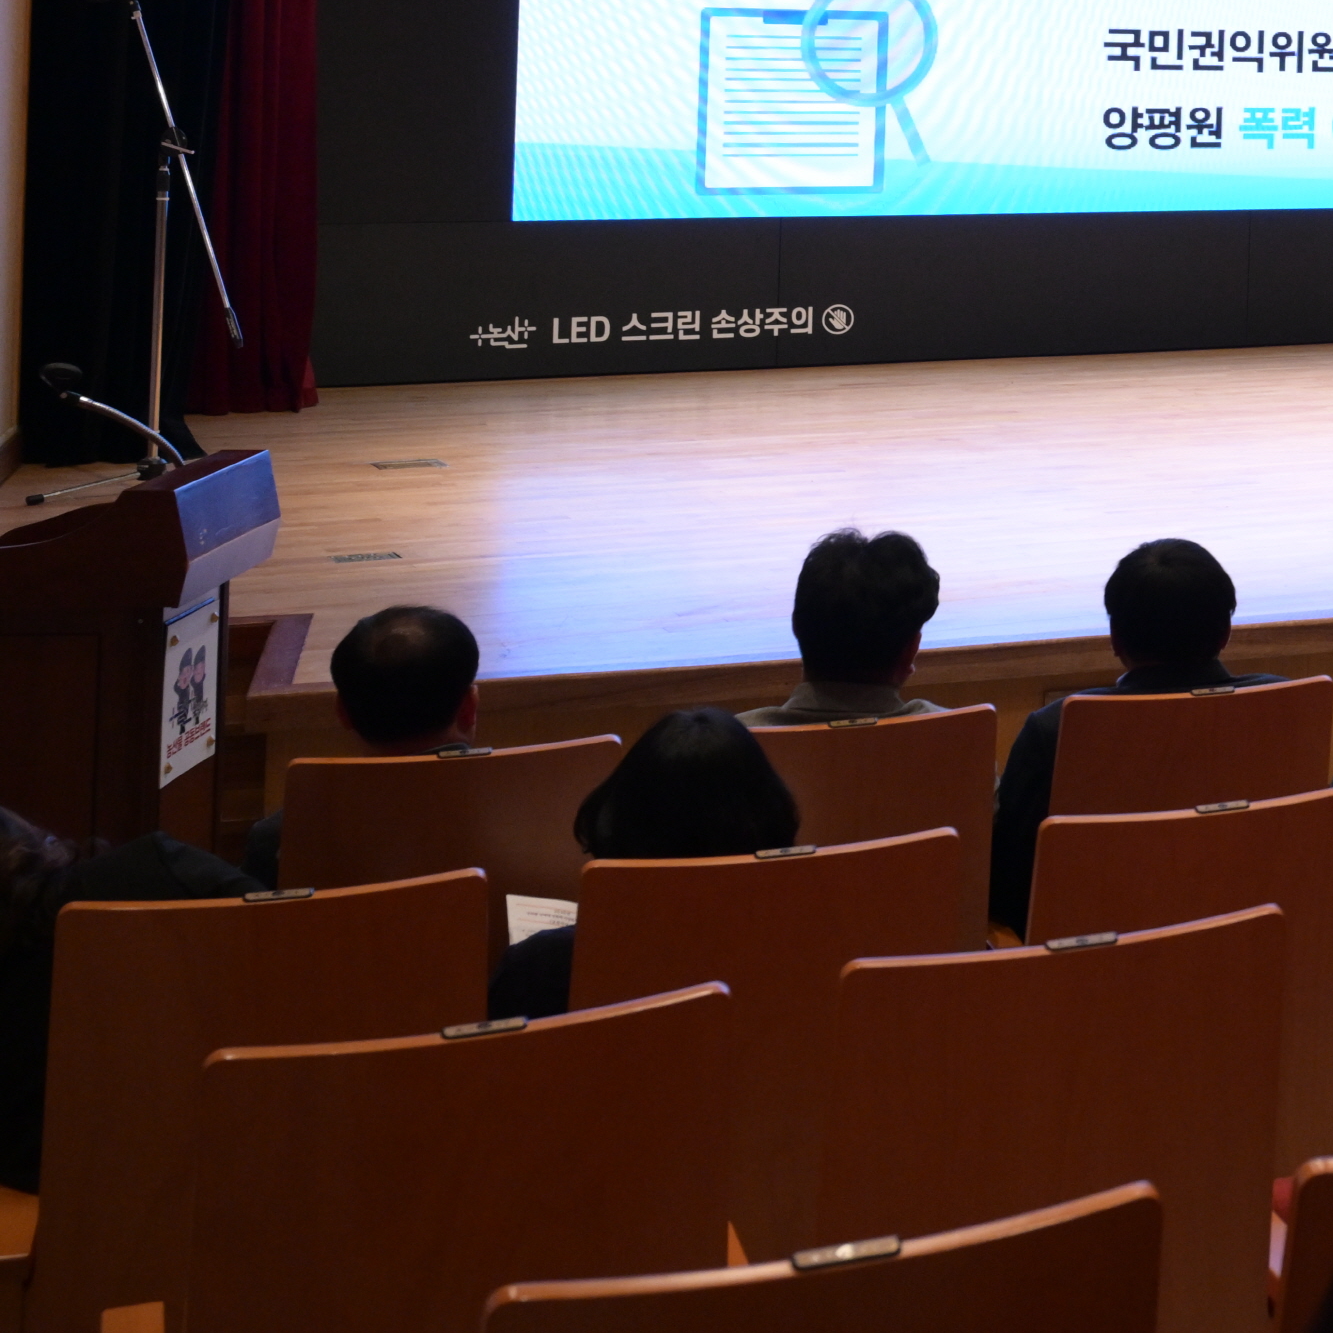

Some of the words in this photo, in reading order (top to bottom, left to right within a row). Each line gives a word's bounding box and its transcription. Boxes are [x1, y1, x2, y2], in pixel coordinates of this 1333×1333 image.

[1102, 106, 1223, 151] 양평원
[1238, 106, 1316, 149] 폭력
[552, 315, 611, 344] LED
[621, 310, 701, 342] 스크린
[711, 306, 813, 339] 손상주의
